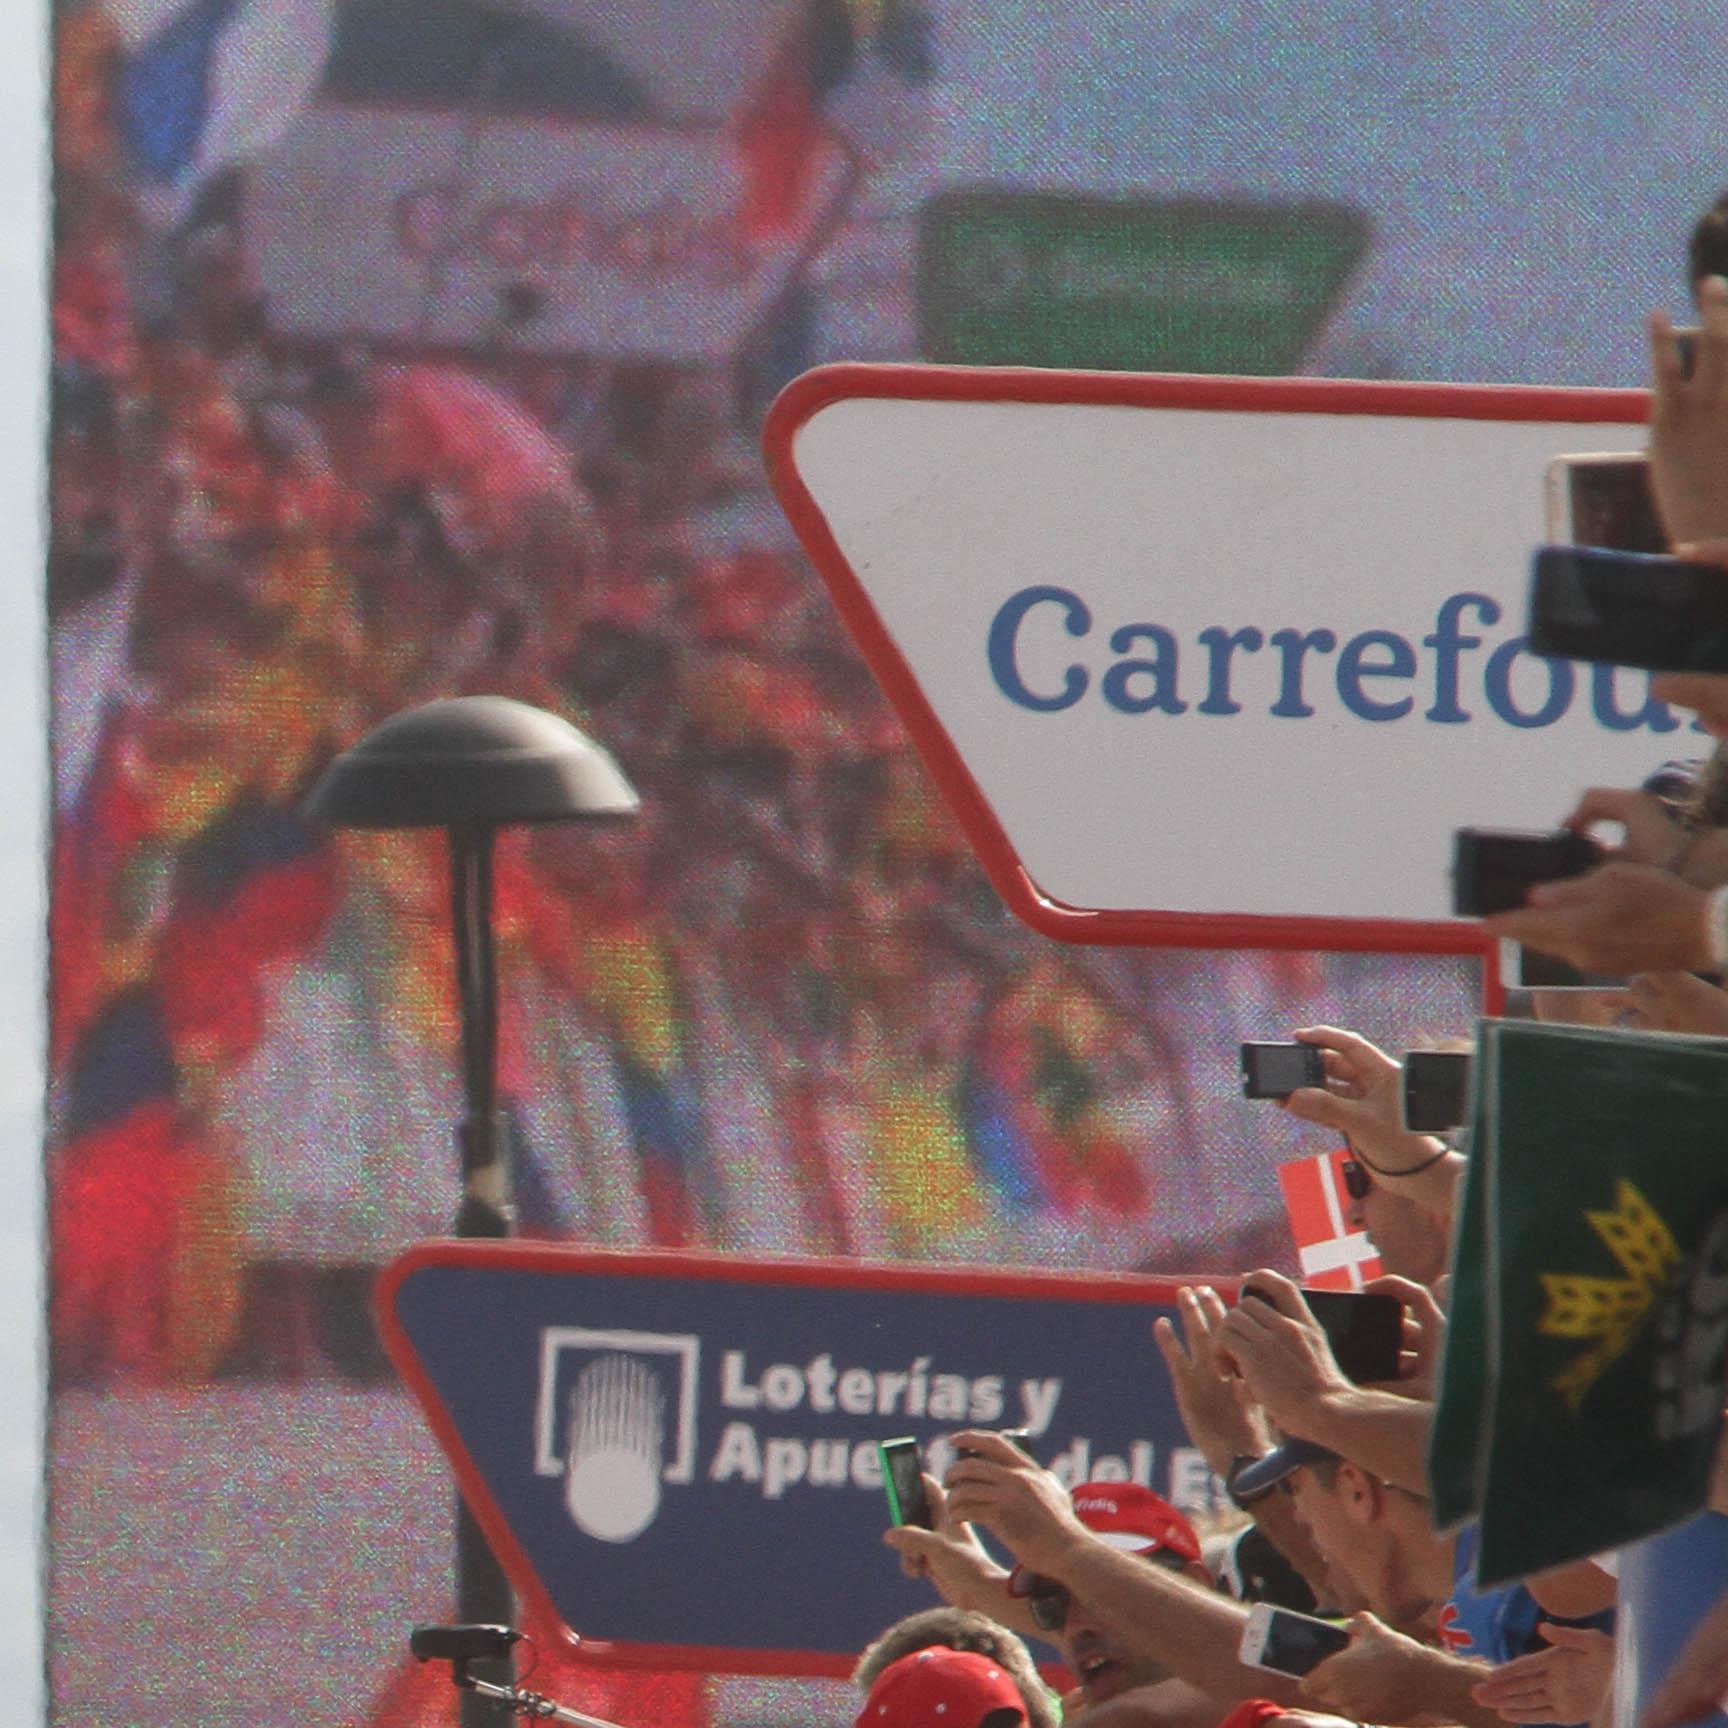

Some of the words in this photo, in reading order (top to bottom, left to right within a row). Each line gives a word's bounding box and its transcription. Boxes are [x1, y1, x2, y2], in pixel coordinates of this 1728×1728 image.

[986, 584, 1709, 733] Carrefou
[719, 1349, 1005, 1423] Loterías
[1020, 1376, 1062, 1438] y
